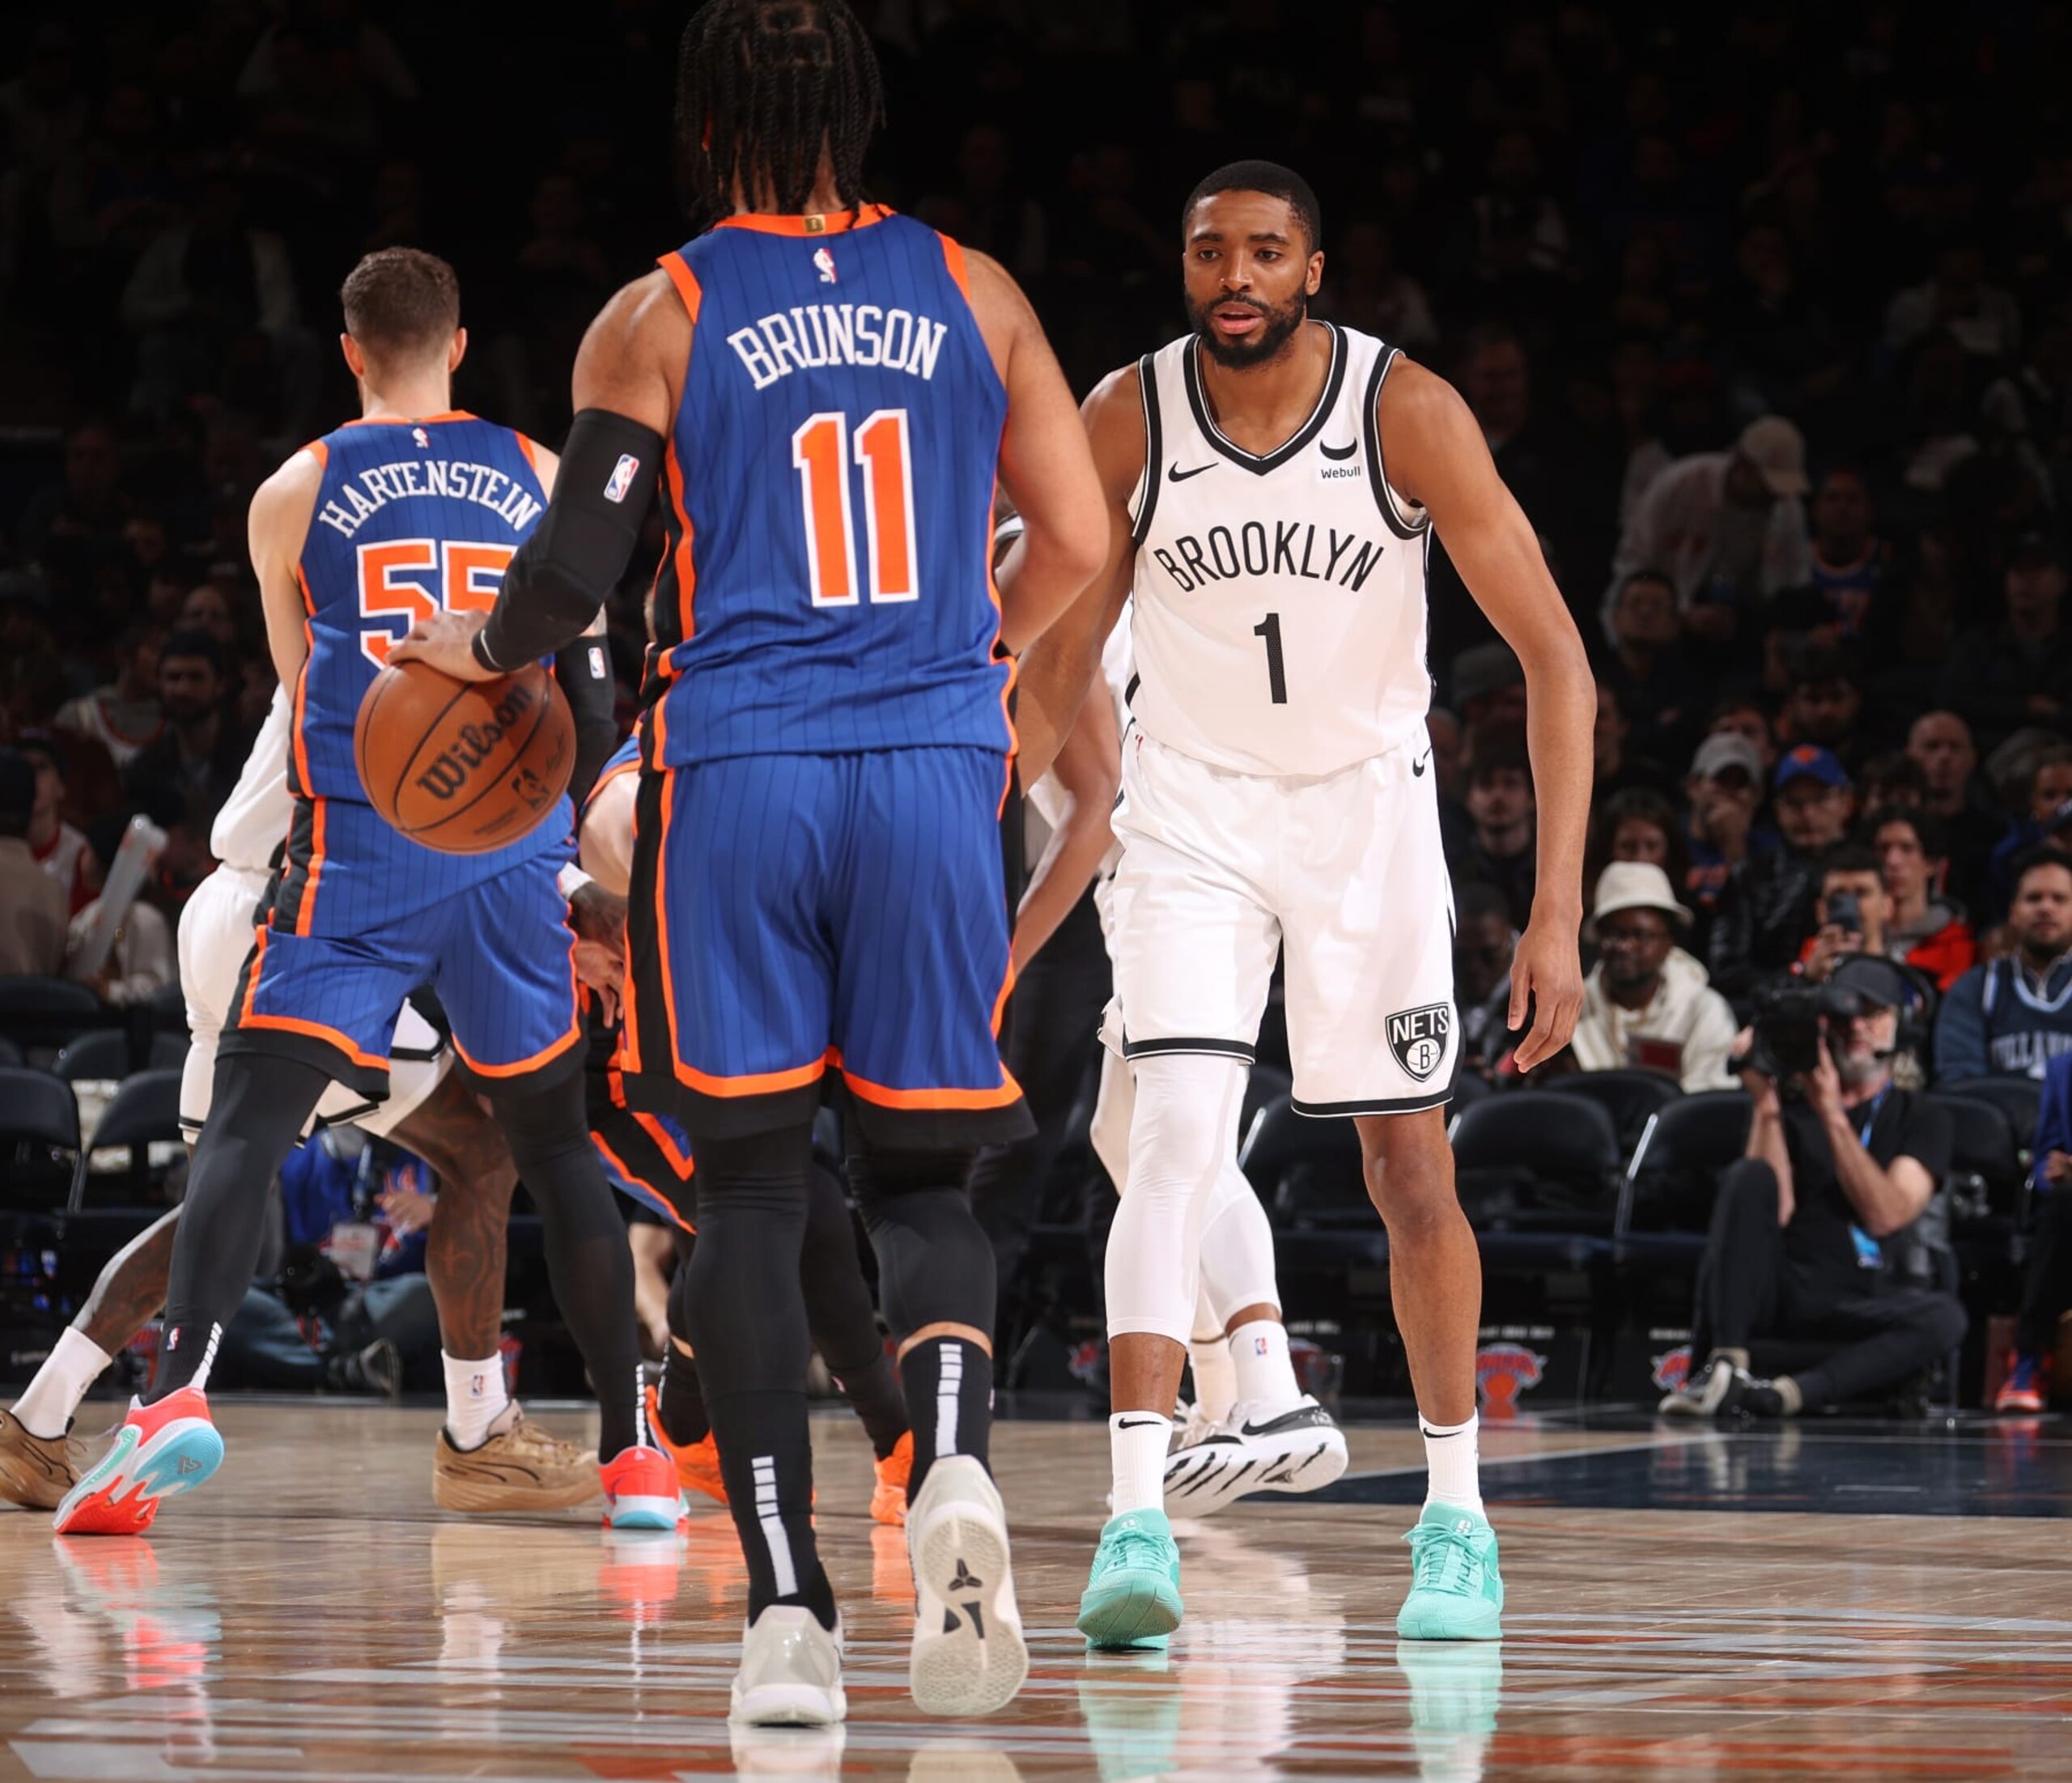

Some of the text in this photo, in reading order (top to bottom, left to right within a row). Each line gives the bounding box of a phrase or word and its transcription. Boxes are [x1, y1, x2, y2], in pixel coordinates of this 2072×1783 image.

[726, 304, 948, 391] BRUNSON
[318, 460, 542, 539] HARTENSTEIN
[792, 408, 919, 608] 11
[1321, 465, 1361, 479] Webull
[1153, 520, 1384, 592] BROOKLYN
[1253, 613, 1288, 704] 1
[415, 685, 533, 801] Wilson
[1392, 1007, 1450, 1045] NETS
[1420, 1043, 1431, 1071] B
